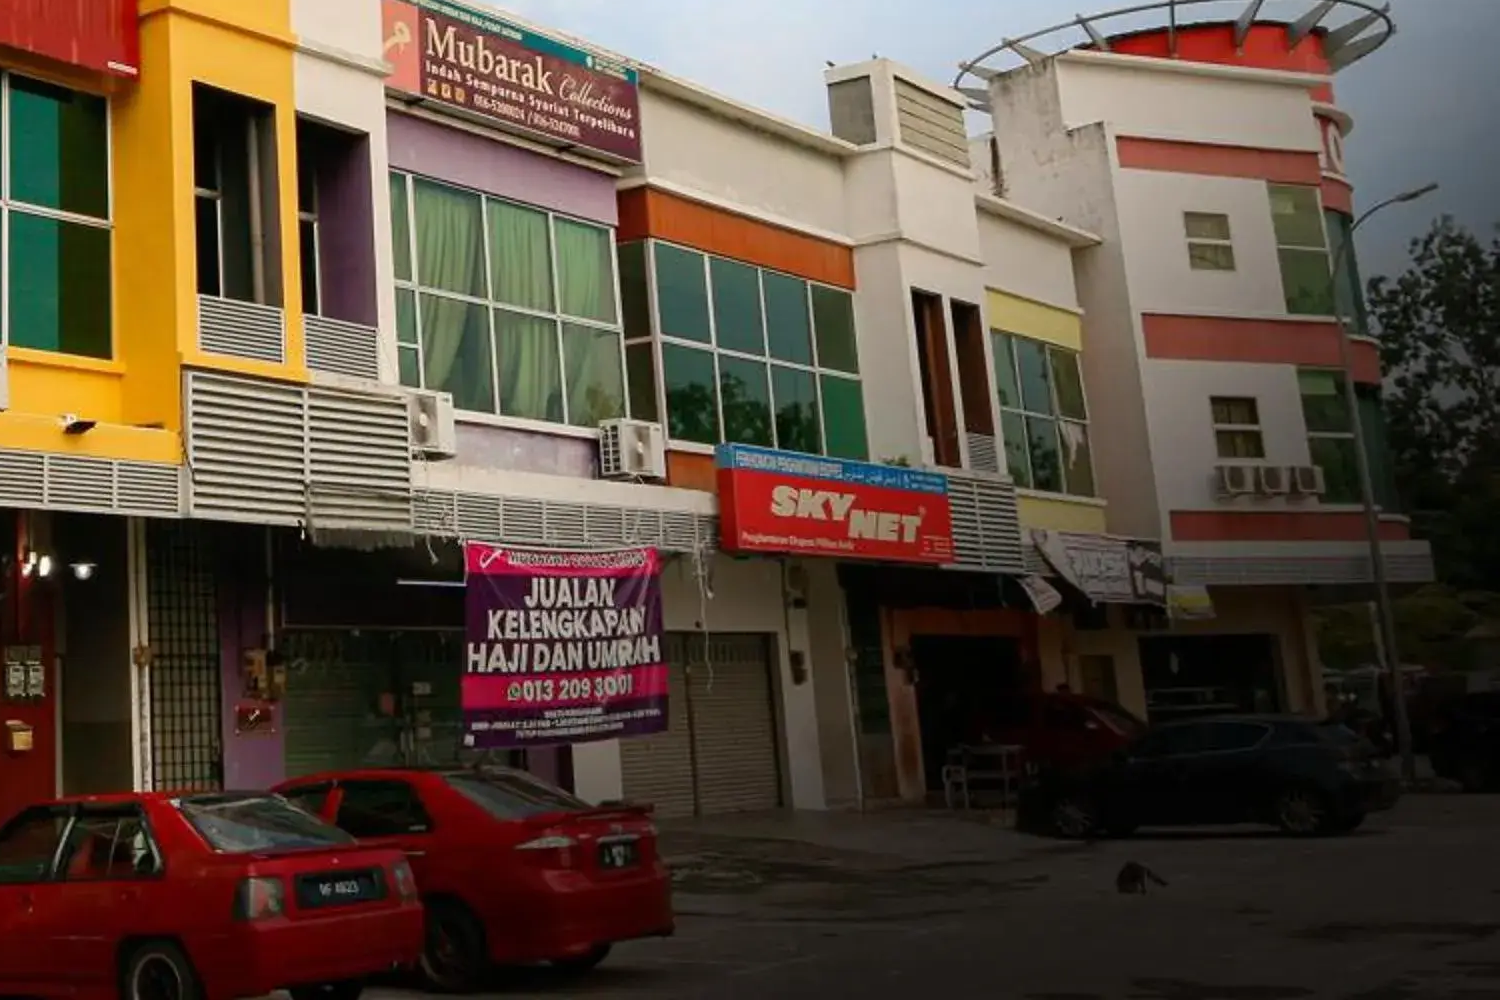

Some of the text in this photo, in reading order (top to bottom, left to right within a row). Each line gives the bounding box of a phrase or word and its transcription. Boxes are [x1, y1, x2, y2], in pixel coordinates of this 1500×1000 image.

[425, 17, 632, 119] Mubarak Collections
[425, 60, 461, 82] Indah
[771, 485, 922, 543] SKY NET
[524, 578, 616, 608] JUALAN
[487, 606, 646, 640] KELENGKAPAN
[467, 635, 661, 673] HAJI DAN UMRAH
[523, 679, 553, 702] 013
